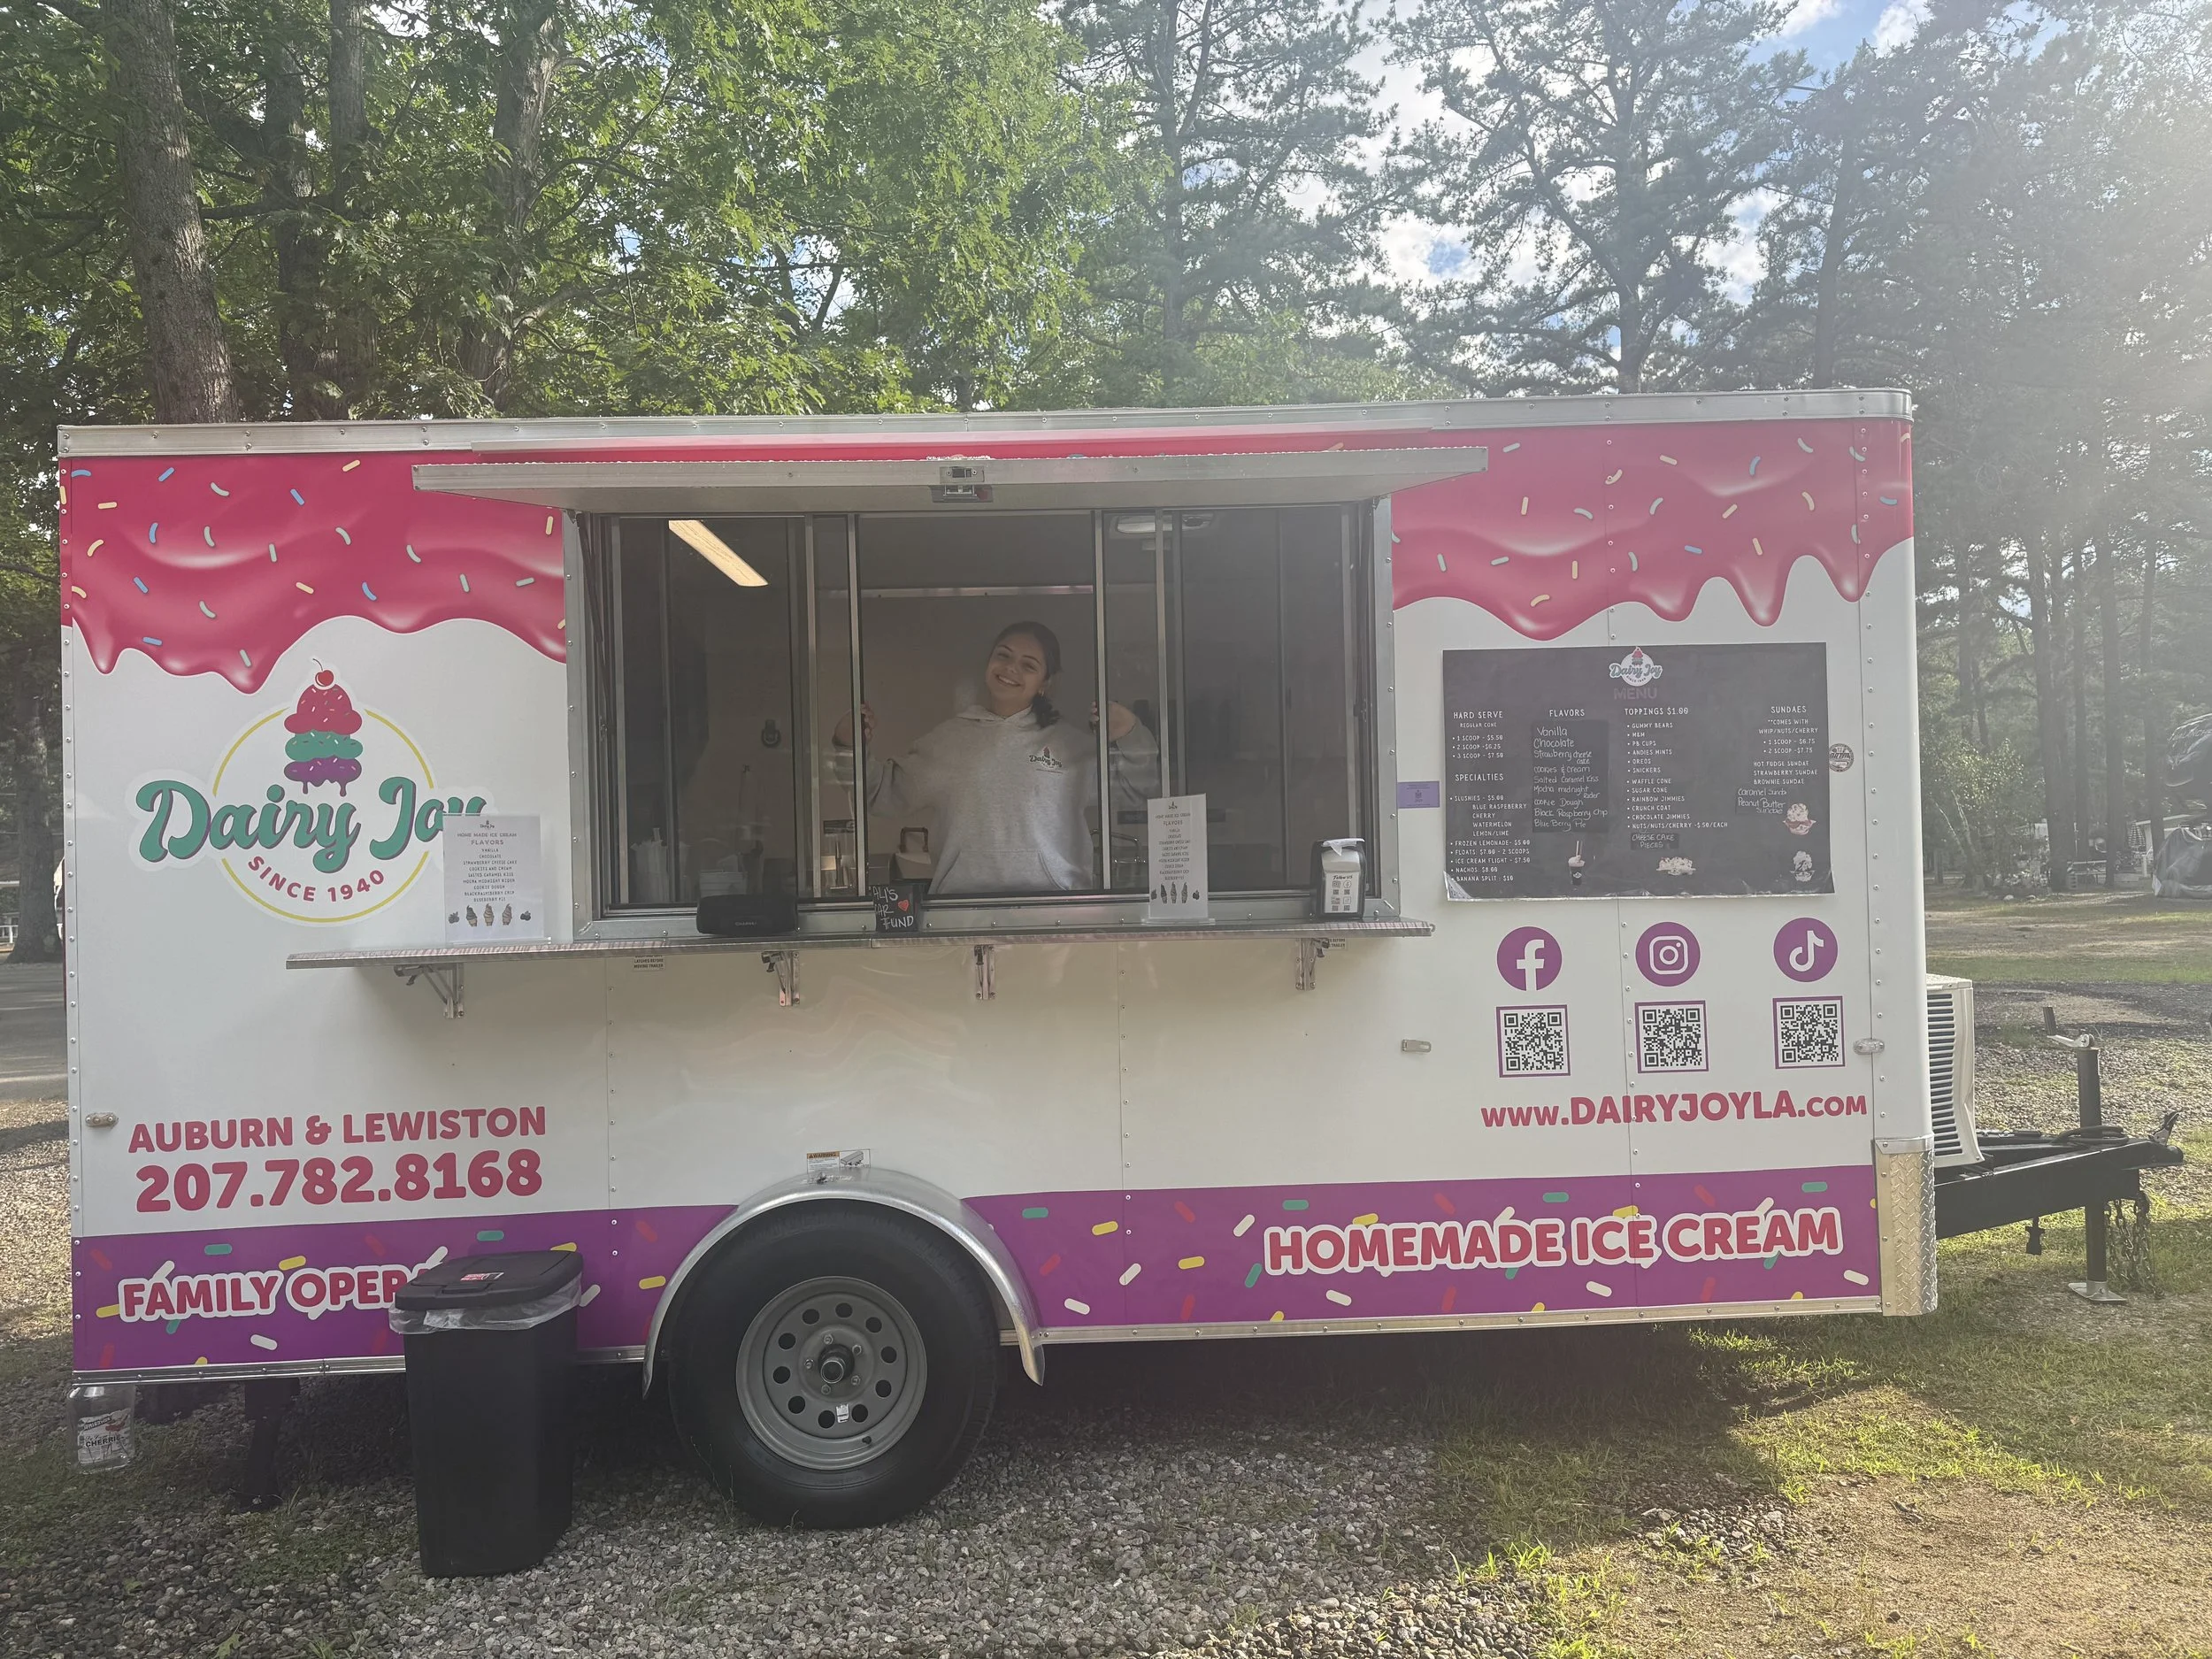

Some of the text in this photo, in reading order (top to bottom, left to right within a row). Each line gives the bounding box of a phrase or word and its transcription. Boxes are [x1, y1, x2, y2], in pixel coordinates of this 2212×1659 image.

[1610, 664, 1662, 679] Dairy Joy
[1614, 687, 1657, 699] MENU
[1537, 726, 1568, 736] Vanilla
[1533, 738, 1574, 748] Chocolate
[1533, 749, 1572, 761] Strawberry
[1533, 786, 1555, 795] Mocha
[1560, 798, 1584, 809] Dough
[1738, 797, 1786, 808] Peanut Butter
[135, 779, 362, 874] Dairy
[1551, 819, 1571, 832] Berry
[1572, 819, 1586, 828] Pie
[247, 856, 386, 903] SINCE 1940
[872, 887, 898, 902] ALI'S
[880, 916, 914, 930] FUND
[128, 1106, 547, 1153] AUBURN & LEWISTON
[135, 1148, 543, 1213] 207.782.8168
[1267, 1210, 1839, 1271] HOMEMADE ICE CREAM
[123, 1276, 278, 1317] FAMILY
